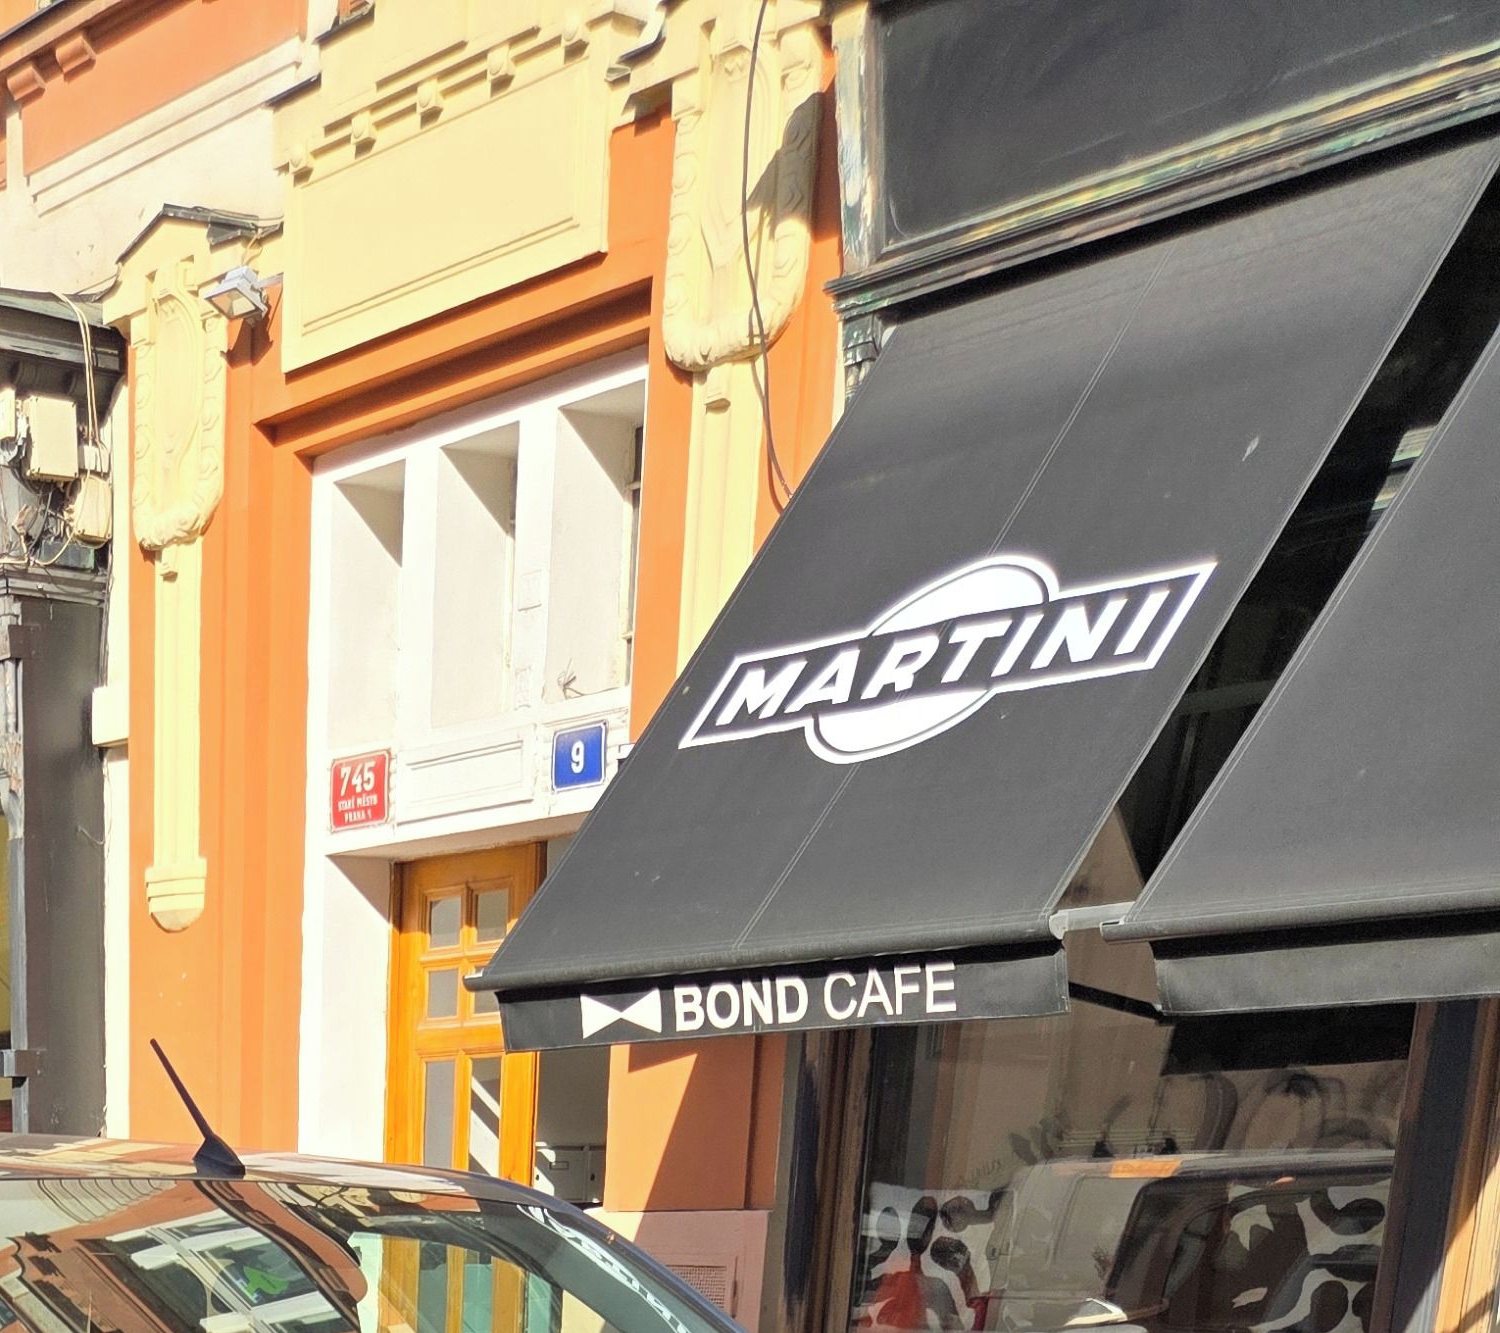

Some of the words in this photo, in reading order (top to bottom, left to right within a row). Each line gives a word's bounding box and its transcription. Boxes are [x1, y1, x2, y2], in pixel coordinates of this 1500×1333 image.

[714, 588, 1172, 727] MARTINI
[340, 760, 376, 797] 745
[569, 740, 585, 774] 9
[673, 976, 810, 1033] BOND
[822, 960, 958, 1021] CAFE
